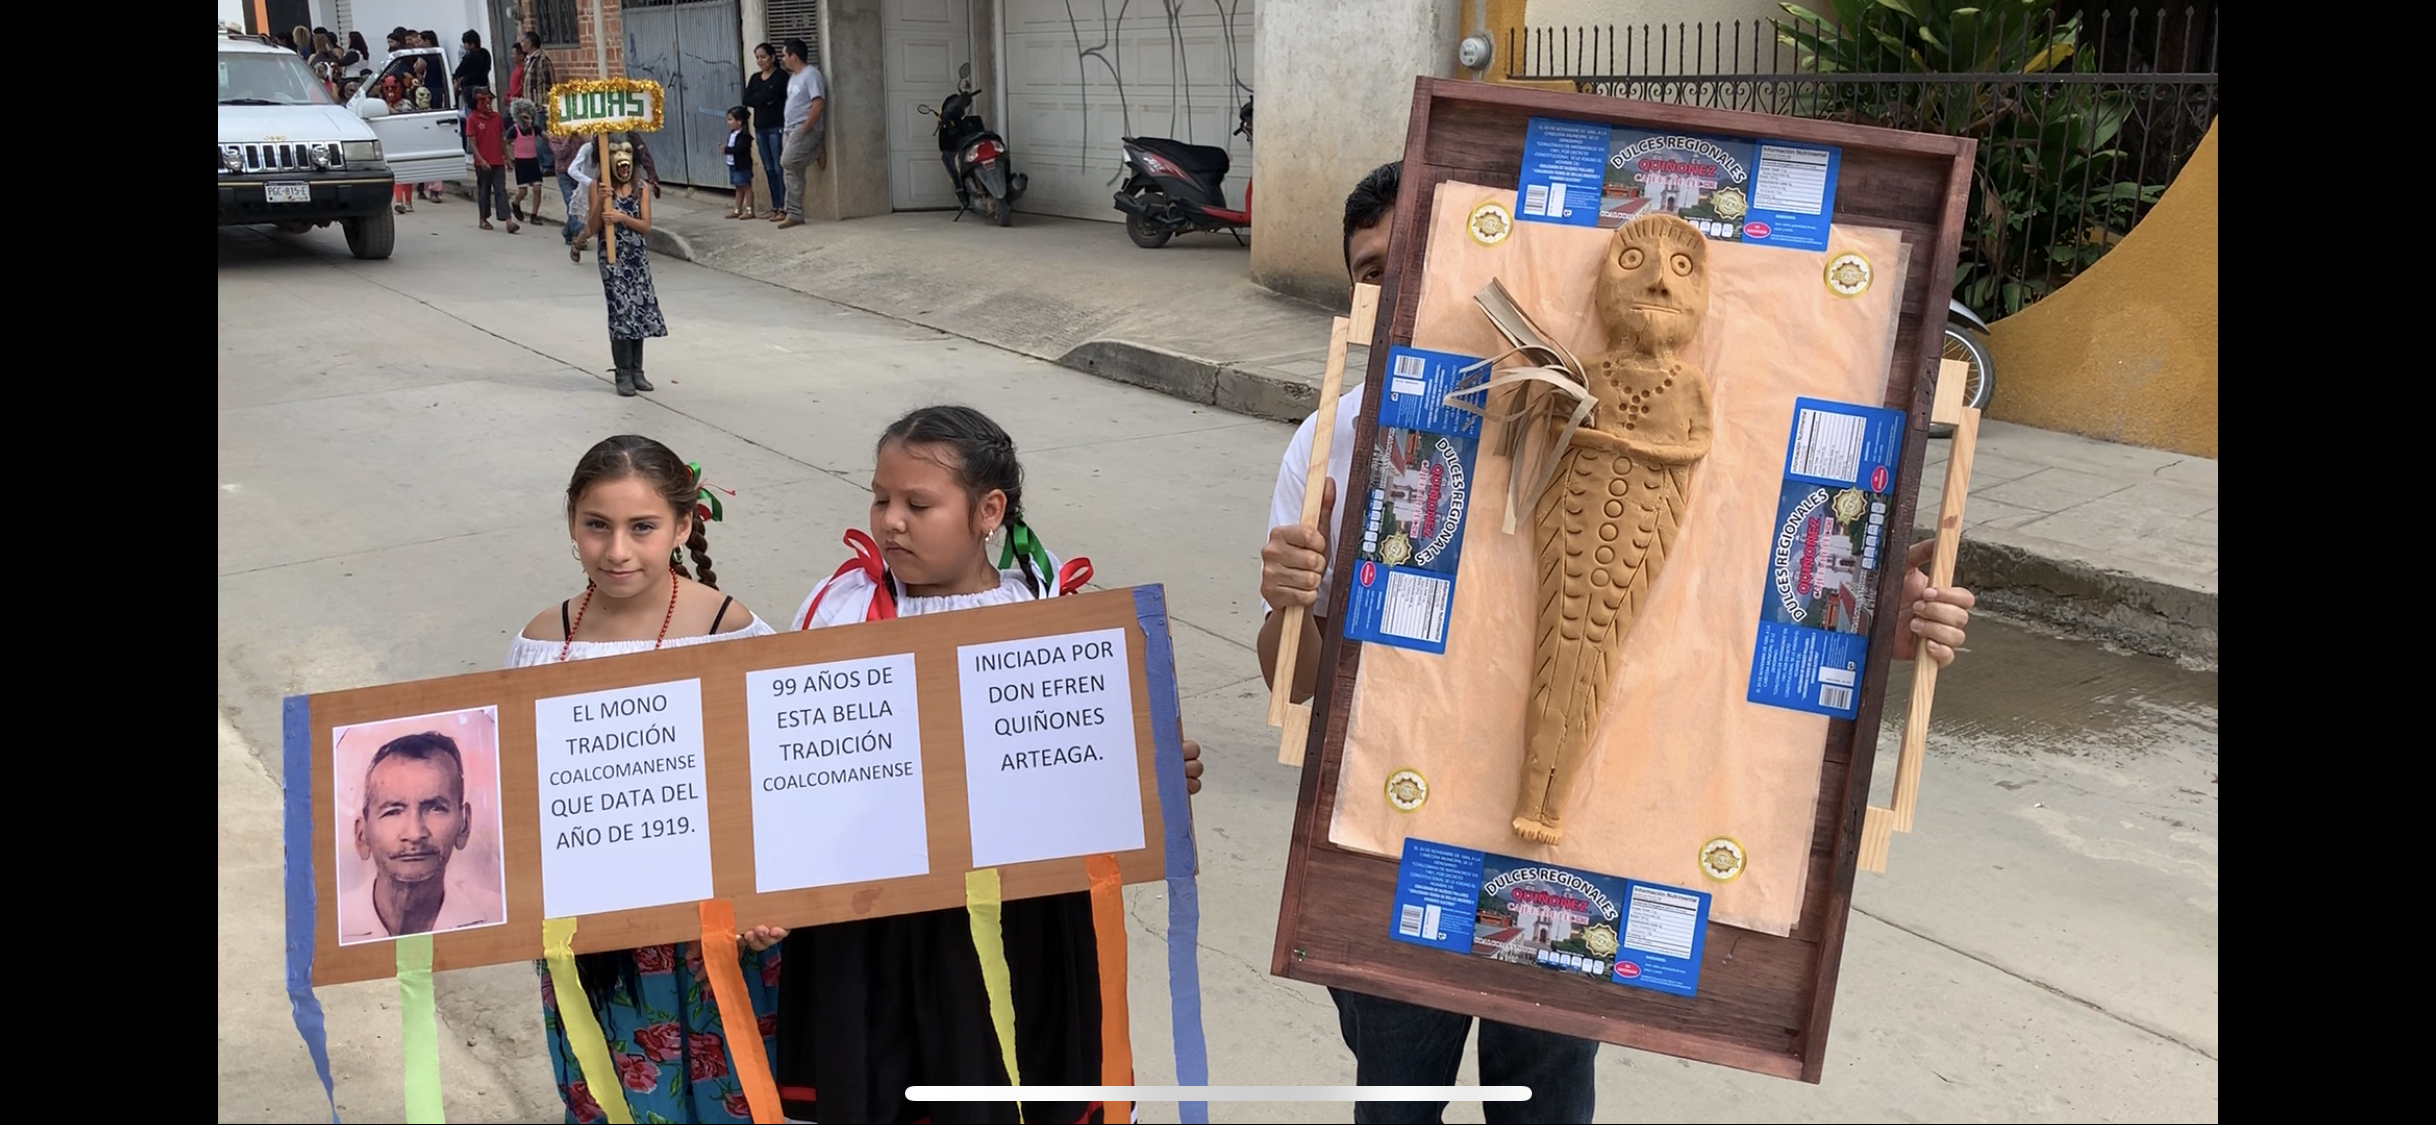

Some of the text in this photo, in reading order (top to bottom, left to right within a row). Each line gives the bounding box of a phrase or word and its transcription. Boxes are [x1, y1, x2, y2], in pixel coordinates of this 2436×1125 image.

[1612, 137, 1664, 168] DULCES
[1667, 136, 1746, 183] REGIONALES
[1638, 158, 1717, 176] QUIÑONEZ
[1436, 438, 1464, 488] DULCES
[1422, 463, 1444, 538] QUIÑONEZ
[1415, 492, 1464, 565] REGIONALES
[1775, 488, 1828, 622] DULCES REGIONALES
[1797, 517, 1820, 594] QUIÑONEZ
[975, 641, 1114, 672] INICIADA POR
[772, 667, 893, 697] 99 AÑOS DE
[989, 675, 1105, 704] DON EFREN
[573, 694, 667, 722] EL MONO
[777, 700, 893, 729] ESTA BELLA
[994, 708, 1105, 736] QUIÑONES
[566, 723, 676, 756] TRADICIÓN
[779, 730, 892, 761] TRADICIÓN
[550, 754, 696, 786] COALCOMANENSE
[1001, 744, 1104, 771] ARTEAGA.
[763, 762, 913, 792] COALCOMANENSE
[551, 782, 698, 818] QUE DATA DEL
[556, 816, 695, 850] AÑO DE 1919.
[1485, 868, 1536, 895] DULCES
[1540, 868, 1618, 920] REGIONALES
[1511, 888, 1588, 911] QUIÑONEZ
